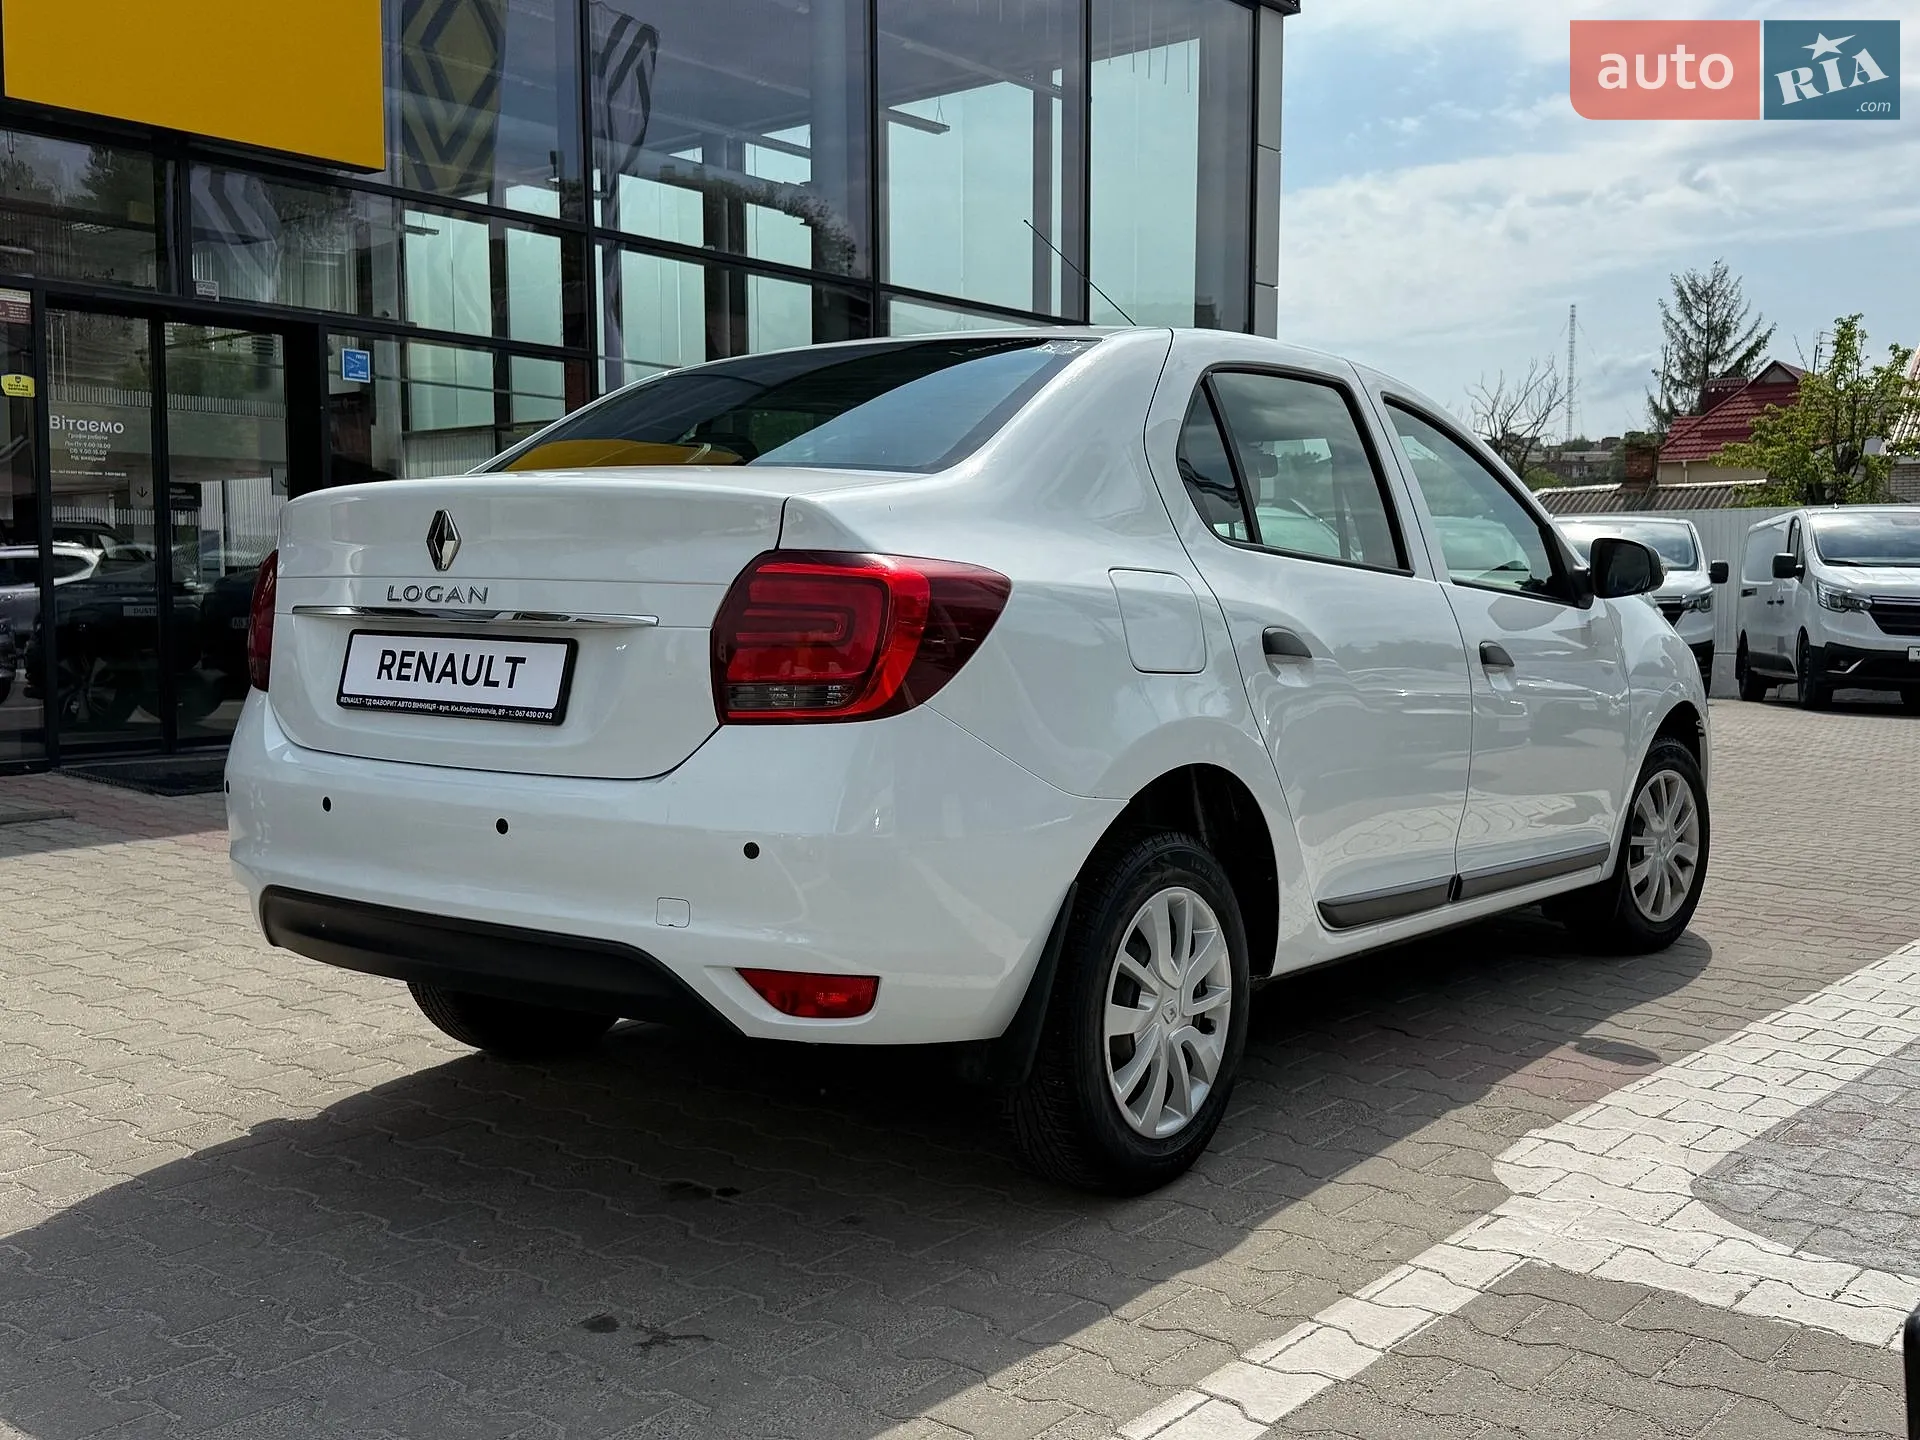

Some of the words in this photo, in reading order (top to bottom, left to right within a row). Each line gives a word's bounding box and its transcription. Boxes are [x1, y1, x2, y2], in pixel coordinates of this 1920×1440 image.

[50, 415, 124, 434] Вітаємо
[386, 584, 489, 605] LOGAN
[376, 649, 527, 689] RENAULT
[340, 696, 362, 705] RENAULT
[397, 700, 412, 708] АВТО
